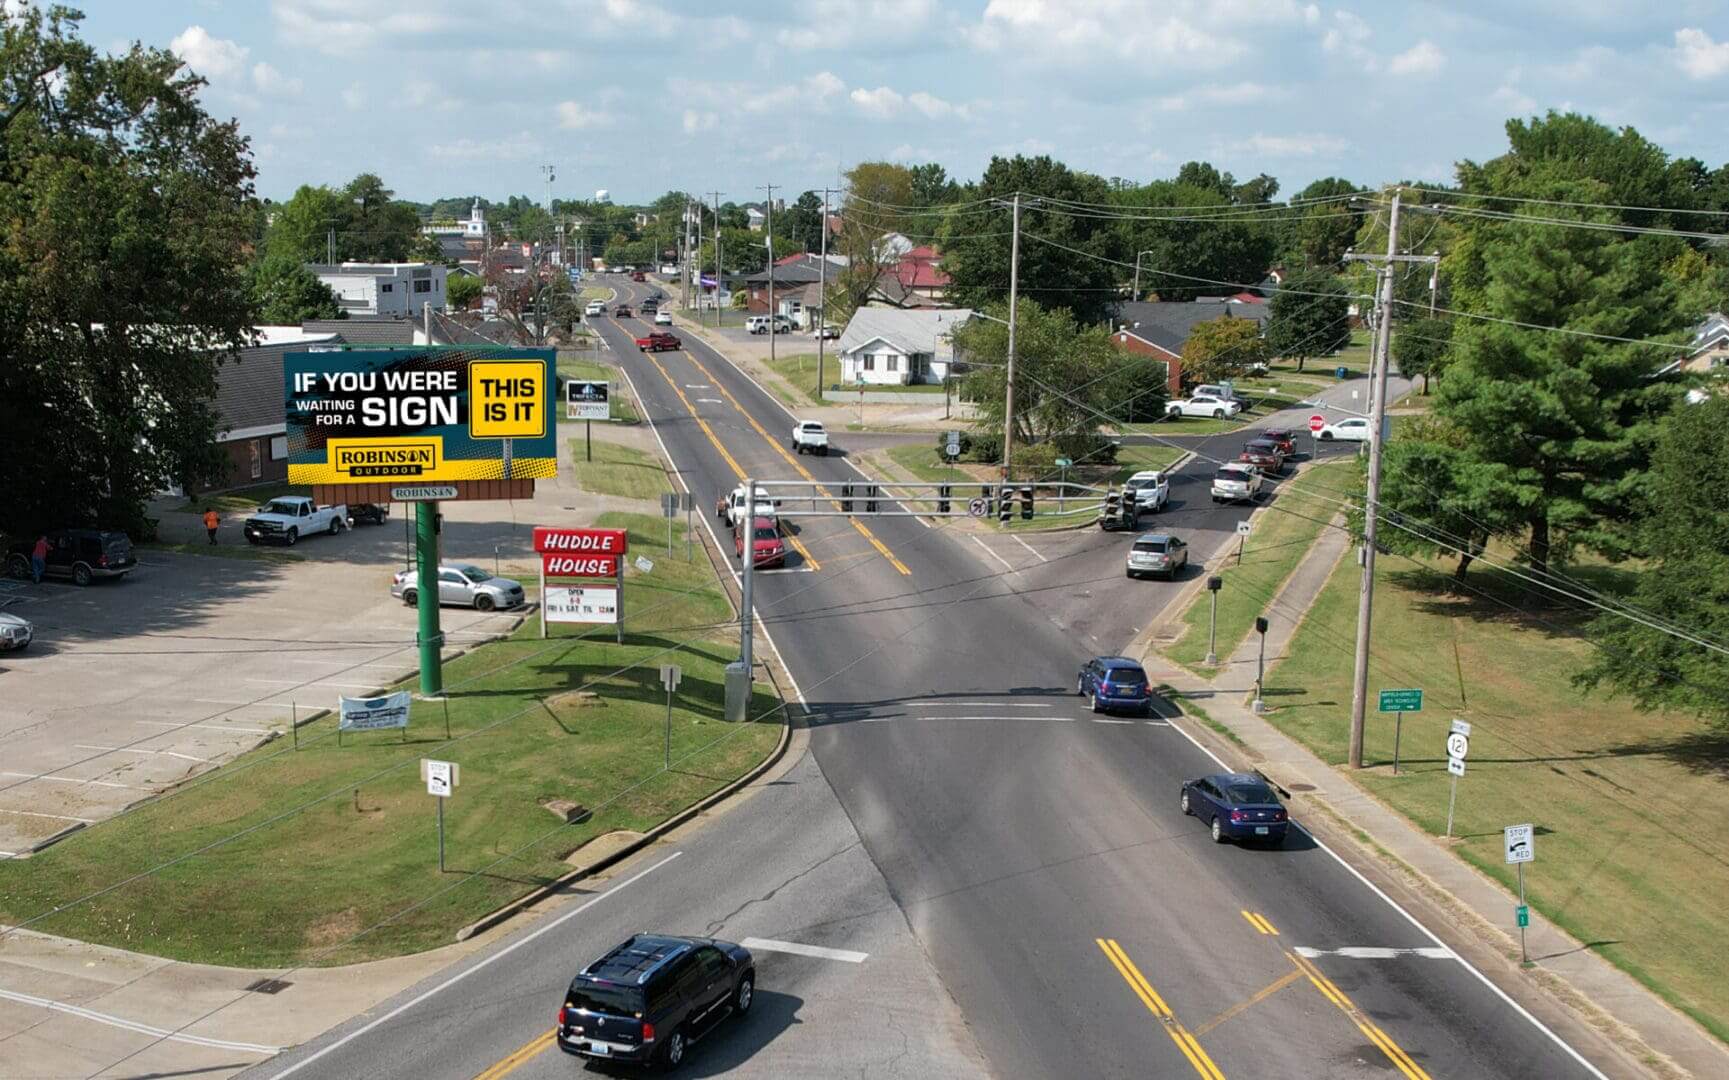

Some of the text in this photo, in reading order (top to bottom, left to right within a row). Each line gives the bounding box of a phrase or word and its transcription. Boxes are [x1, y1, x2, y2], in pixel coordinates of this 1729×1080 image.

[295, 371, 457, 392] IF YOU WERE
[480, 378, 535, 398] THIS
[296, 400, 355, 411] WAITING
[362, 396, 458, 426] SIGN
[484, 402, 535, 422] IS IT
[316, 414, 356, 425] FOR A
[341, 449, 431, 464] ROBINSON
[355, 466, 416, 475] OUTDOOR
[395, 486, 454, 498] ROBINSON
[544, 533, 614, 550] HUDDLE
[548, 557, 610, 574] HOUSE
[568, 588, 584, 596] OPEN
[1452, 738, 1465, 753] 121
[1510, 828, 1528, 837] STOP
[1515, 850, 1529, 858] RED
